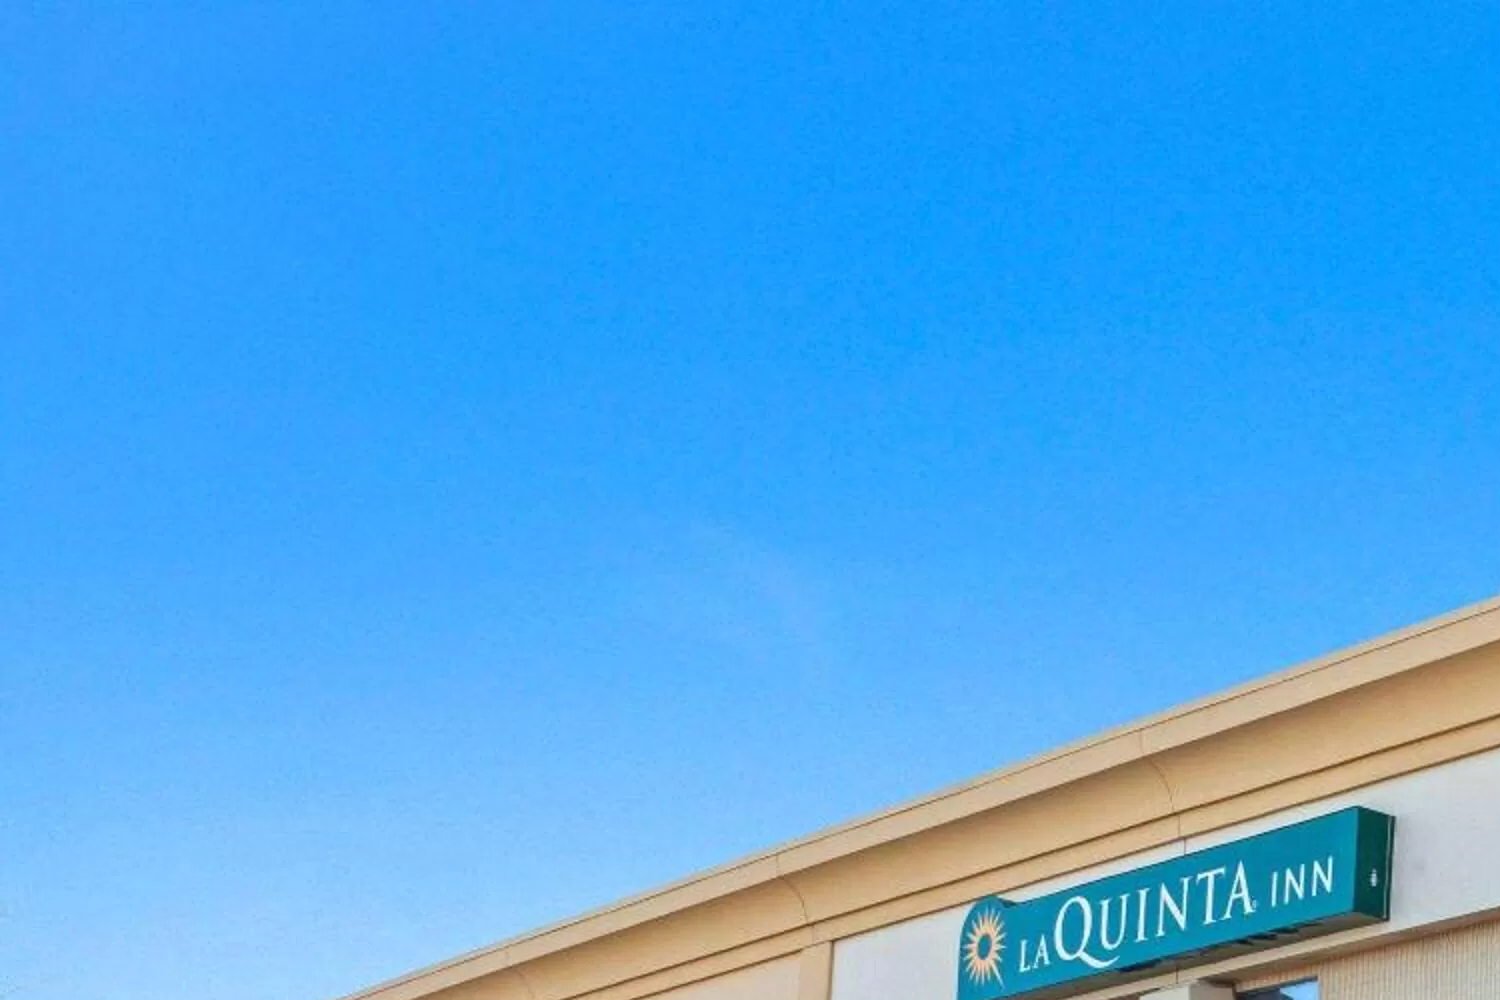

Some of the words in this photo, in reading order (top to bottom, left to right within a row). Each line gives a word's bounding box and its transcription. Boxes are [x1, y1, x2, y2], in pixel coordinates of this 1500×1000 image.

[1018, 935, 1051, 973] LA
[1053, 859, 1256, 969] QUINTA
[1270, 856, 1334, 906] INN
